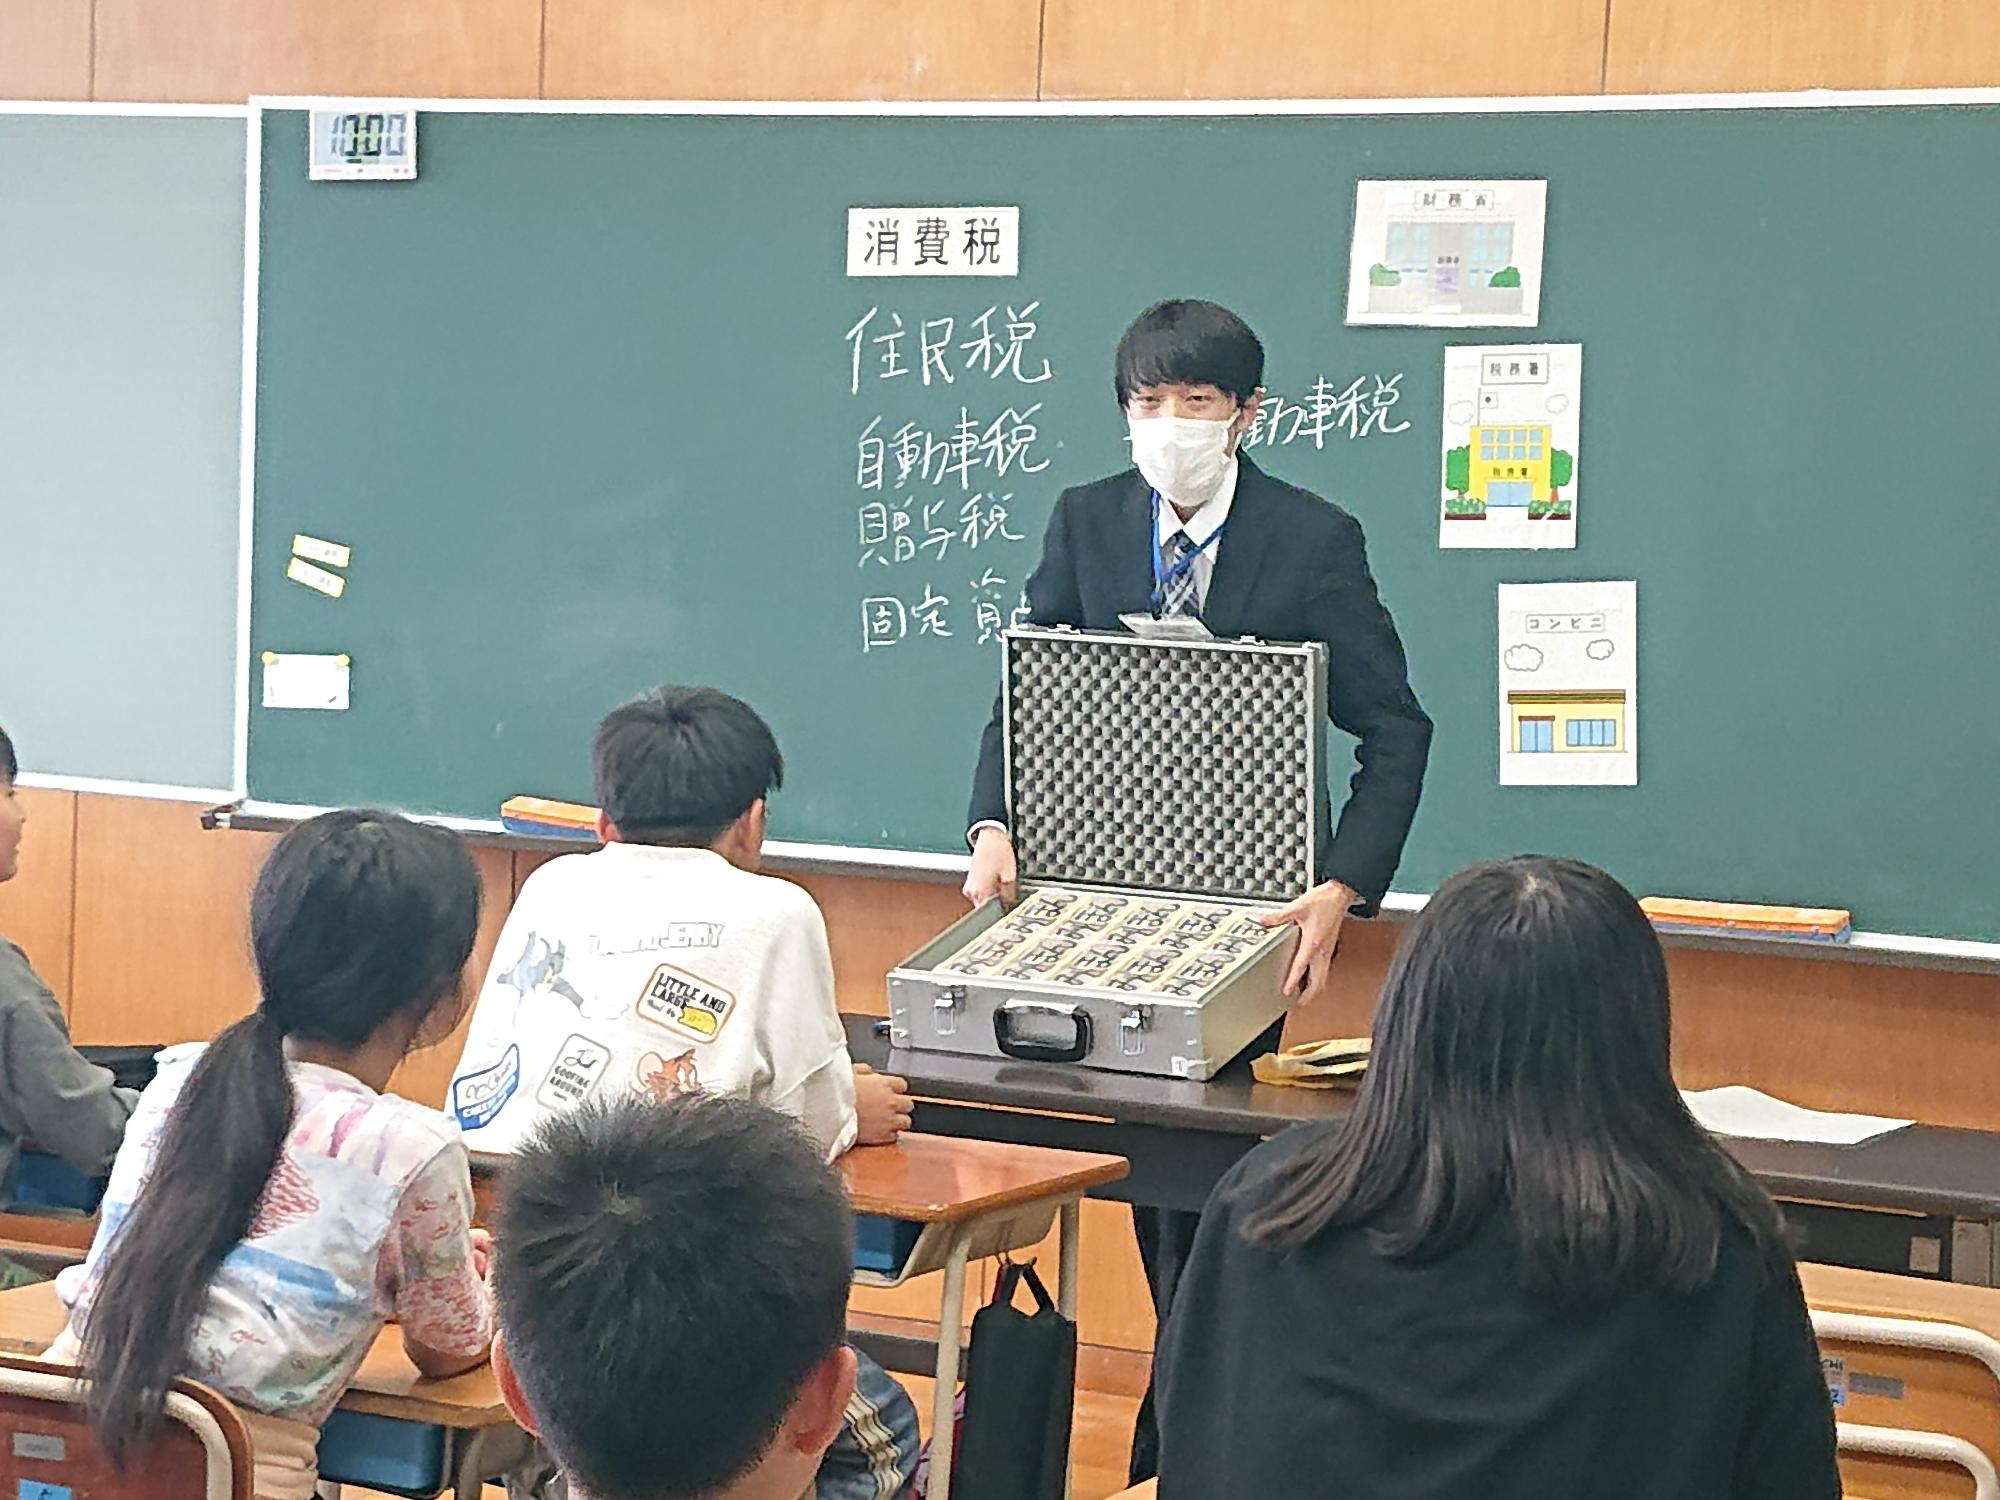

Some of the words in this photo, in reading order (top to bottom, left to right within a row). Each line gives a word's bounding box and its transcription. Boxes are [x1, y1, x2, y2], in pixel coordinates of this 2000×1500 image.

[331, 113, 408, 157] 10:00
[864, 216, 1001, 265] 消費税
[844, 300, 1053, 395] 住民税
[1490, 362, 1539, 376] 税務署
[857, 402, 1050, 490] 自動車税
[858, 492, 1025, 568] 贈与税
[1529, 617, 1602, 629] コンビニ
[657, 972, 701, 1001] LITTLE
[699, 993, 727, 1014] AND
